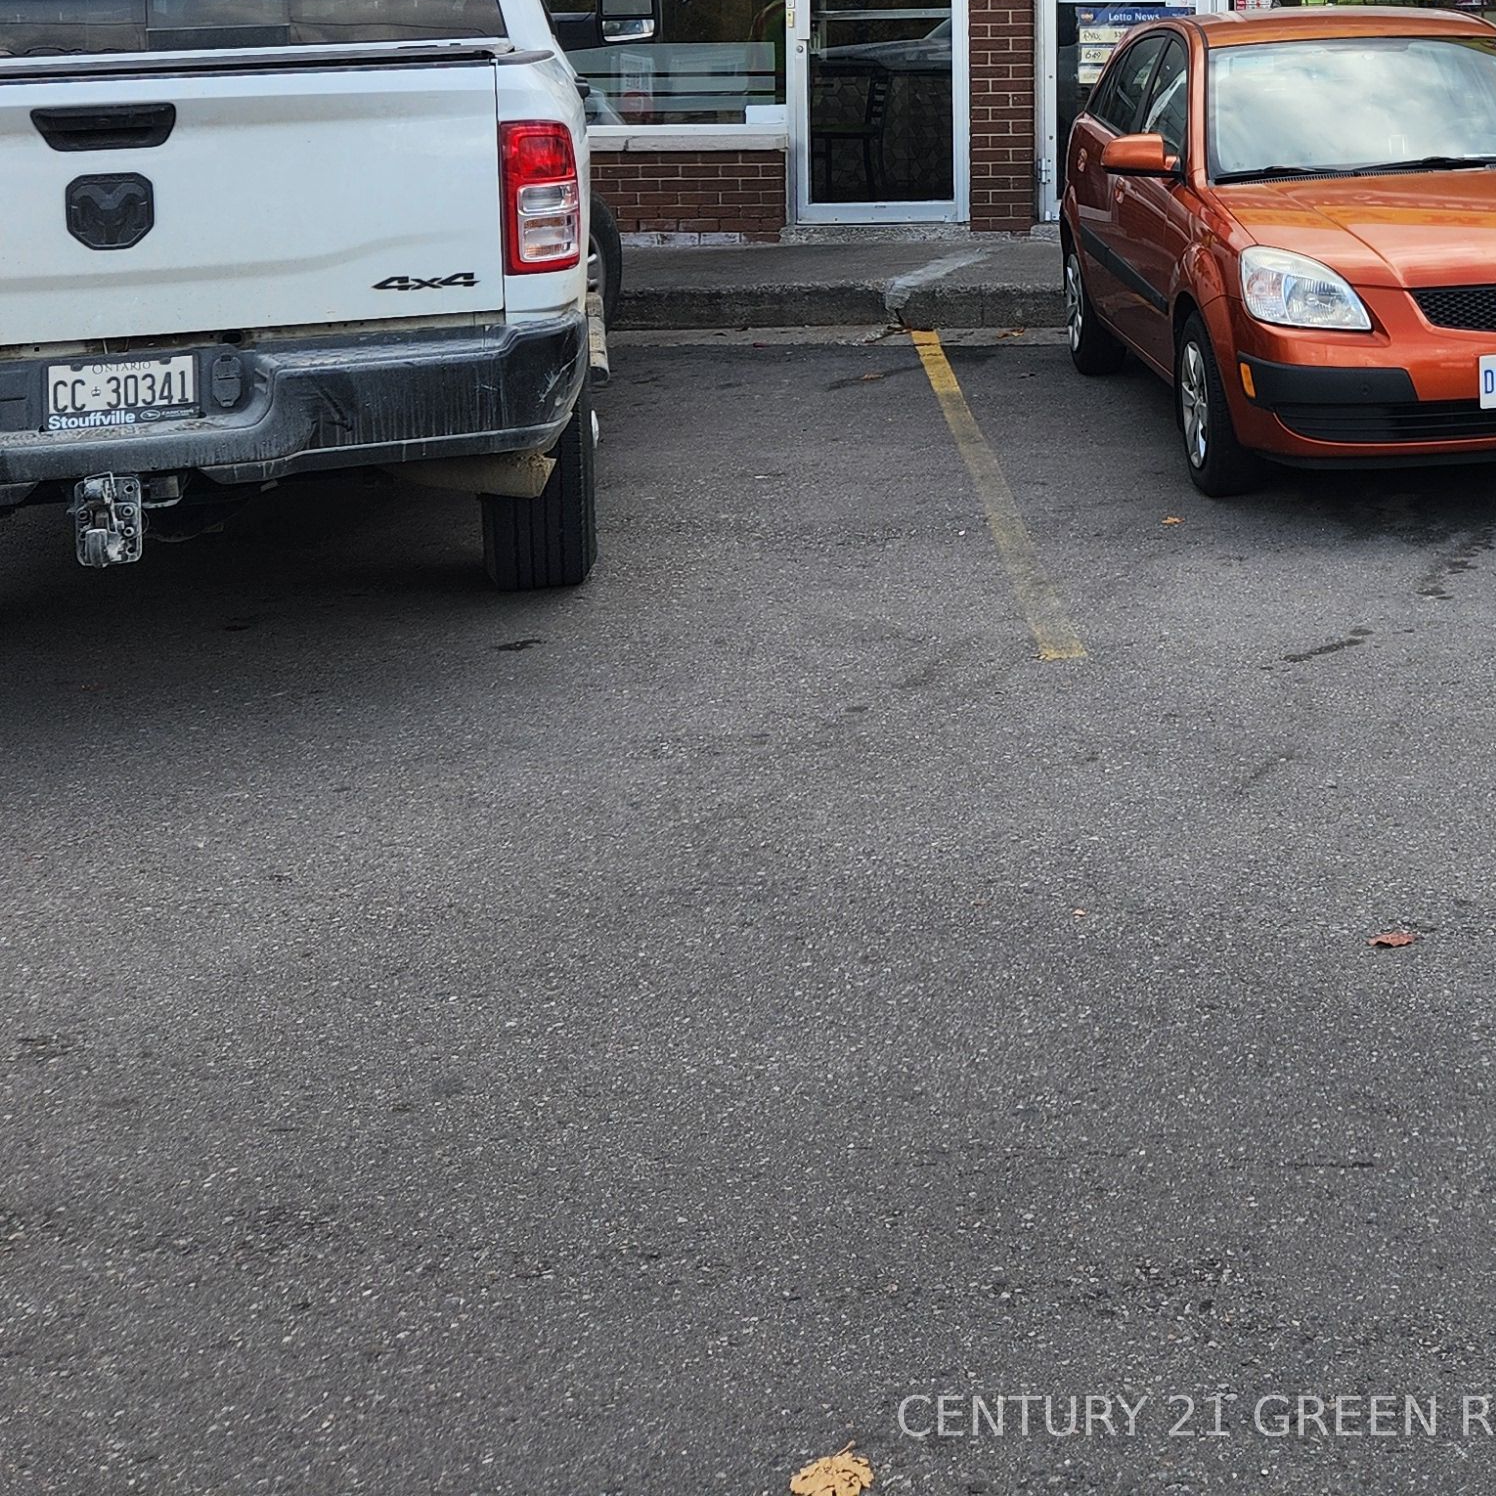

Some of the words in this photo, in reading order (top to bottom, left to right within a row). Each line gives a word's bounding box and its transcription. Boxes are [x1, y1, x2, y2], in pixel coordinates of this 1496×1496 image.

[1108, 12, 1132, 22] Lotto
[1135, 11, 1160, 21] News
[92, 361, 152, 375] ONTARIO
[53, 379, 86, 413] CC
[106, 370, 189, 409] 30341
[48, 410, 136, 430] Stouffville
